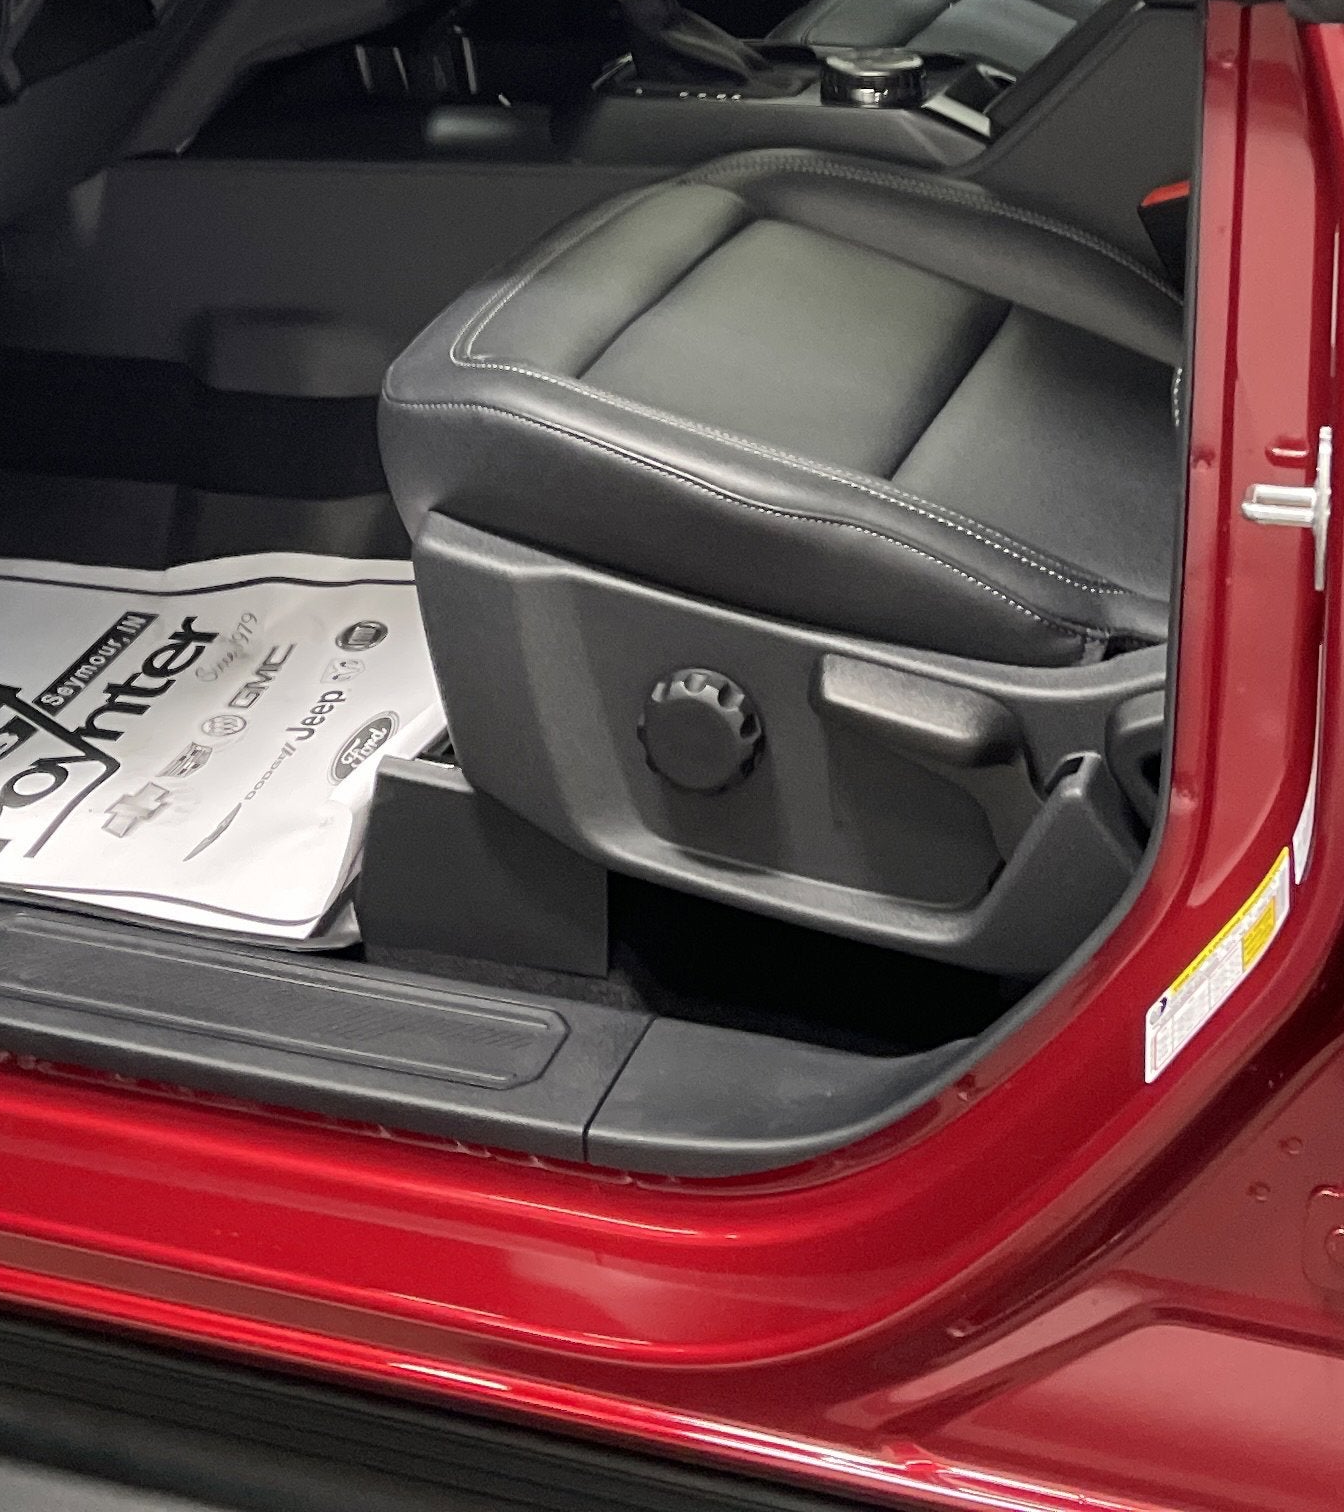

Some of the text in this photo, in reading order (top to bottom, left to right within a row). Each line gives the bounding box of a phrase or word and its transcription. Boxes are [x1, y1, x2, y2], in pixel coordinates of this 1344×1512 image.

[40, 615, 147, 707] Seymour, IN
[227, 643, 296, 709] GMC
[285, 689, 347, 741] Jeep
